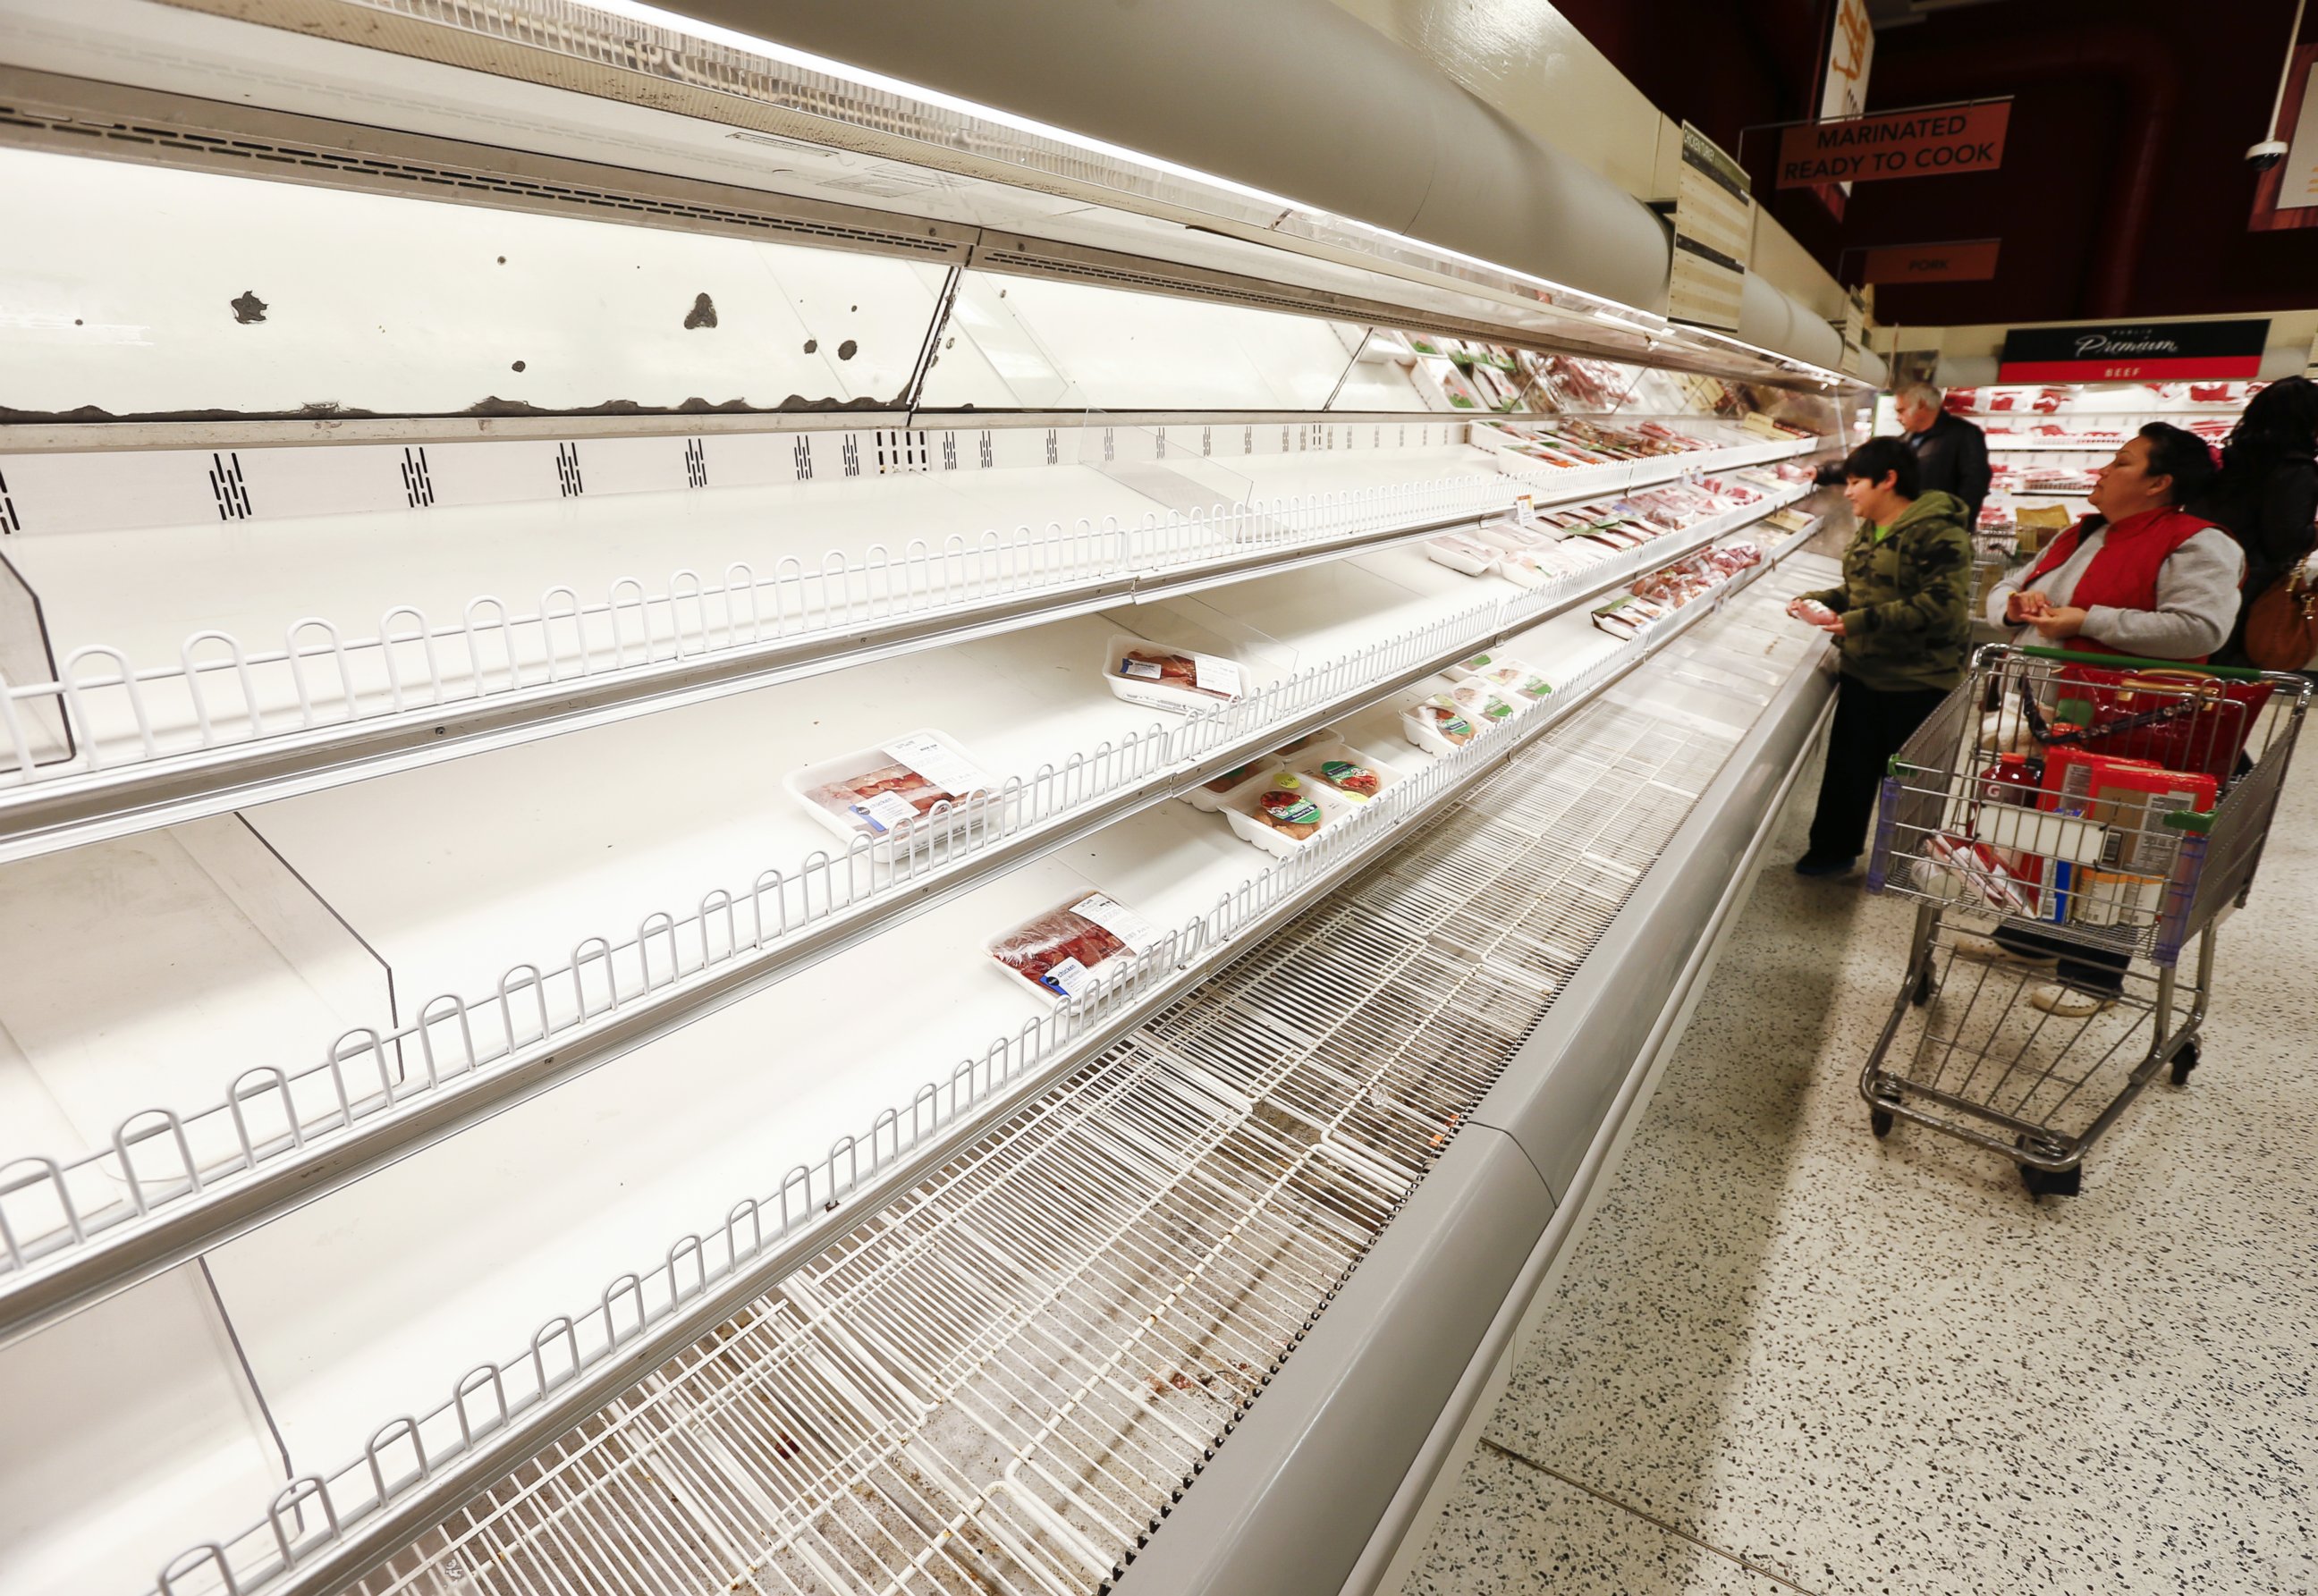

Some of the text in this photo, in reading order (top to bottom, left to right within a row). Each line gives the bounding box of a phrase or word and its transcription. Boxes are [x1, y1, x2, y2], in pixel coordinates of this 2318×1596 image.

[1816, 114, 1967, 150] MARINATED
[1784, 141, 1995, 181] READY TO COOK
[1908, 258, 1950, 271] PORK
[2075, 334, 2178, 357] Premium
[2104, 367, 2141, 377] BEEF
[1986, 783, 2001, 798] G
